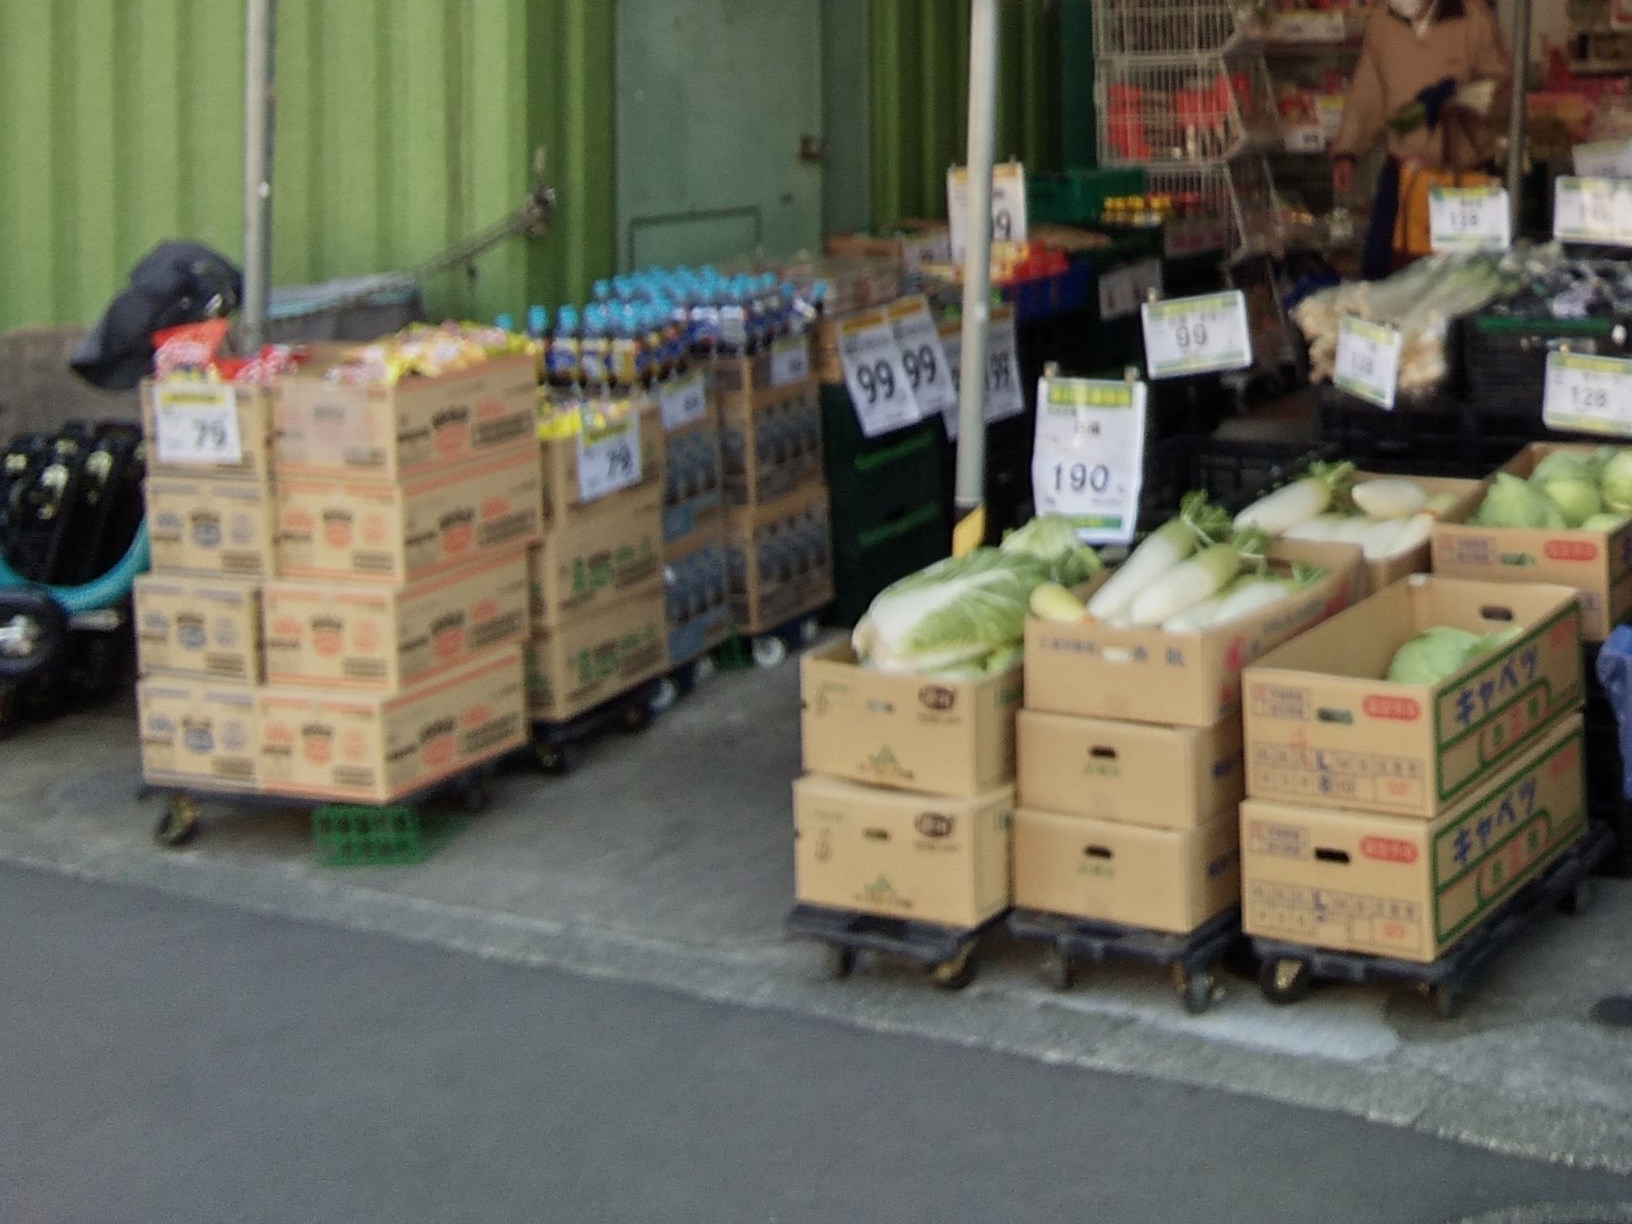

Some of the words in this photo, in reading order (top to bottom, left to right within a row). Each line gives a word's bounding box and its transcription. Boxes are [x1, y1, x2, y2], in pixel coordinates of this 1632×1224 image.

[1174, 322, 1209, 349] 99
[856, 358, 896, 404] 99
[902, 343, 937, 391] 99
[1053, 462, 1110, 493] 190
[1454, 644, 1538, 725] キャベツ
[1453, 776, 1537, 865] キャベツ
